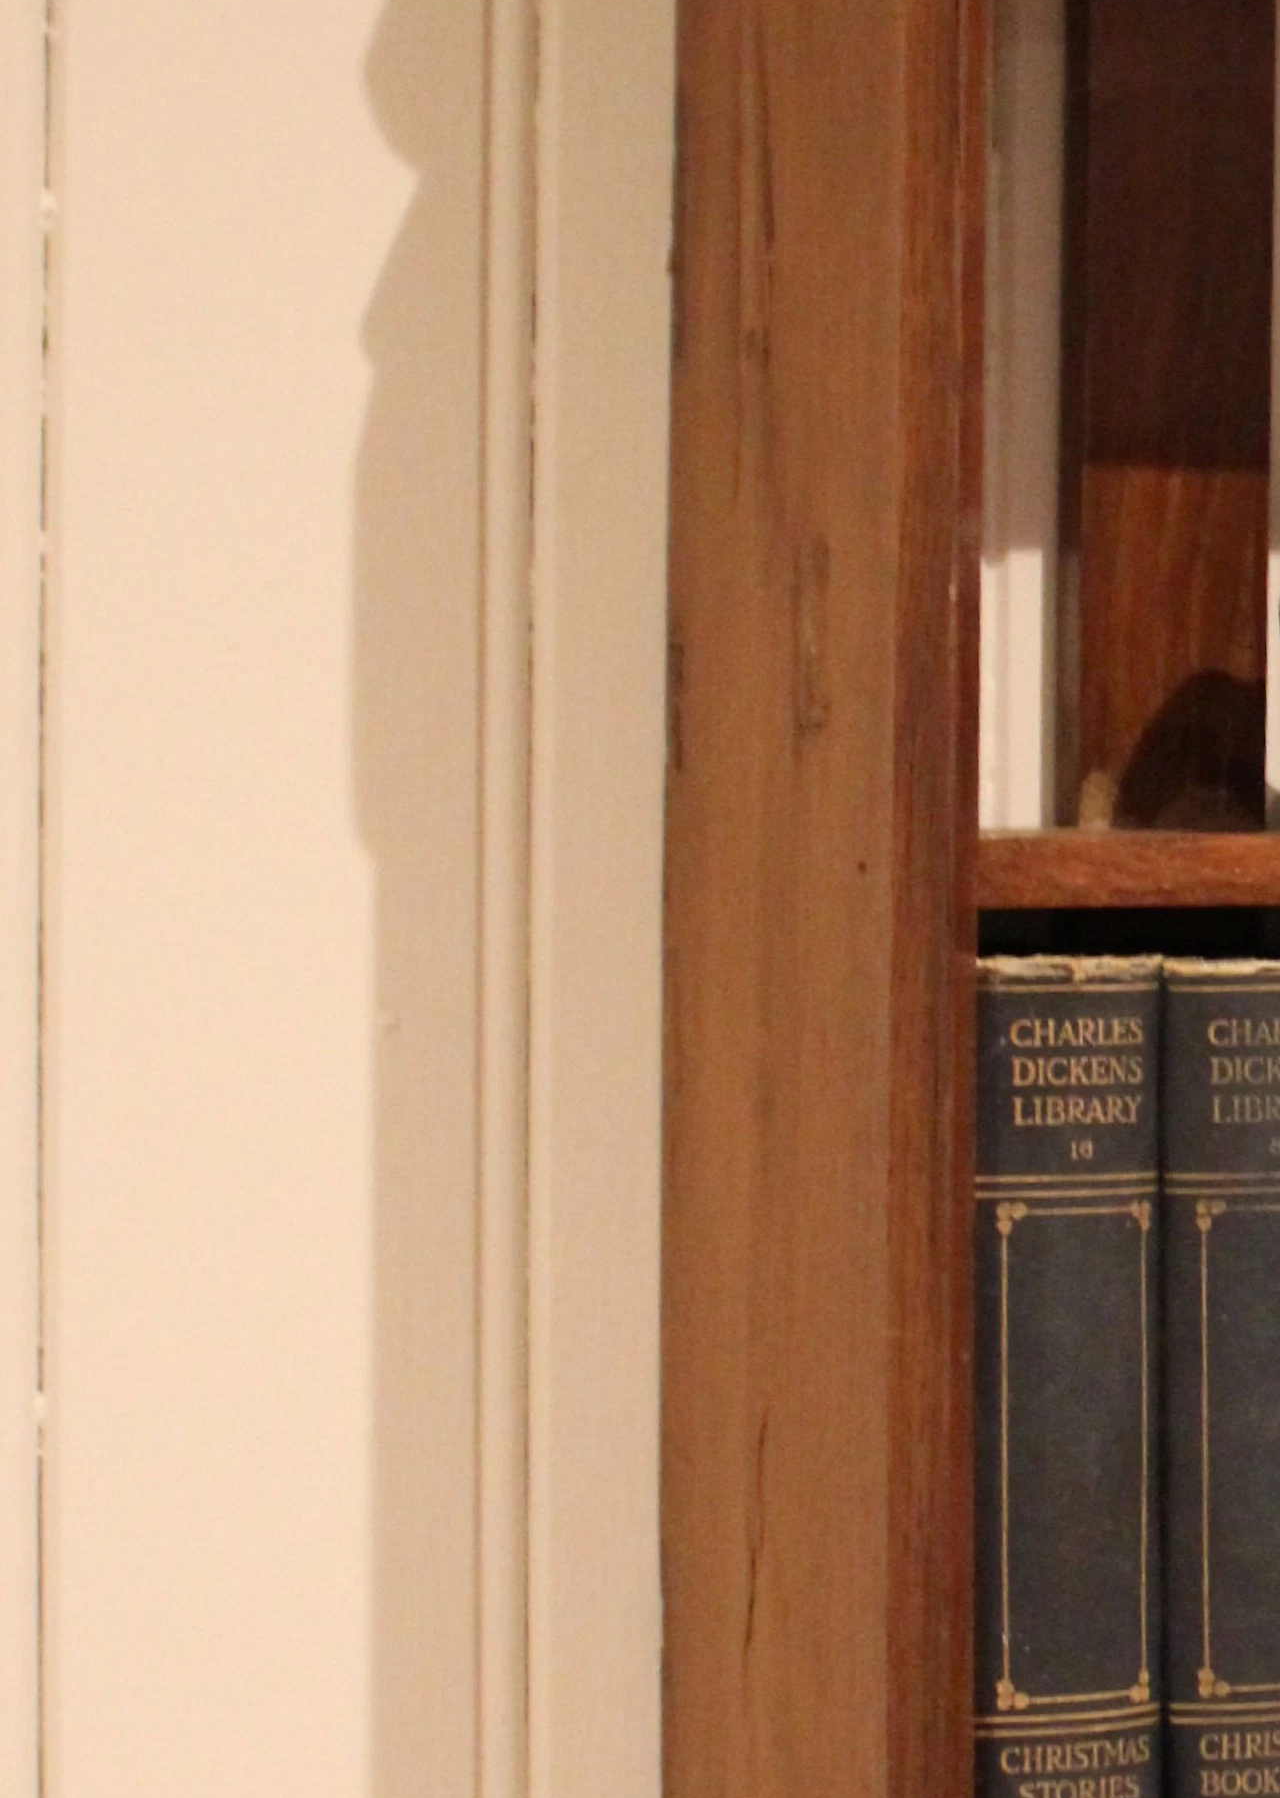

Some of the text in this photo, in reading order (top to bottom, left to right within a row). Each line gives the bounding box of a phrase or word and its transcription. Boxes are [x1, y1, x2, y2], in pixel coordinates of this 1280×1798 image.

[1010, 1016, 1144, 1048] CHARLES
[1011, 1055, 1144, 1087] DICKENS
[1013, 1093, 1143, 1126] LIBRARY
[1000, 1734, 1151, 1775] CHRISTMAS
